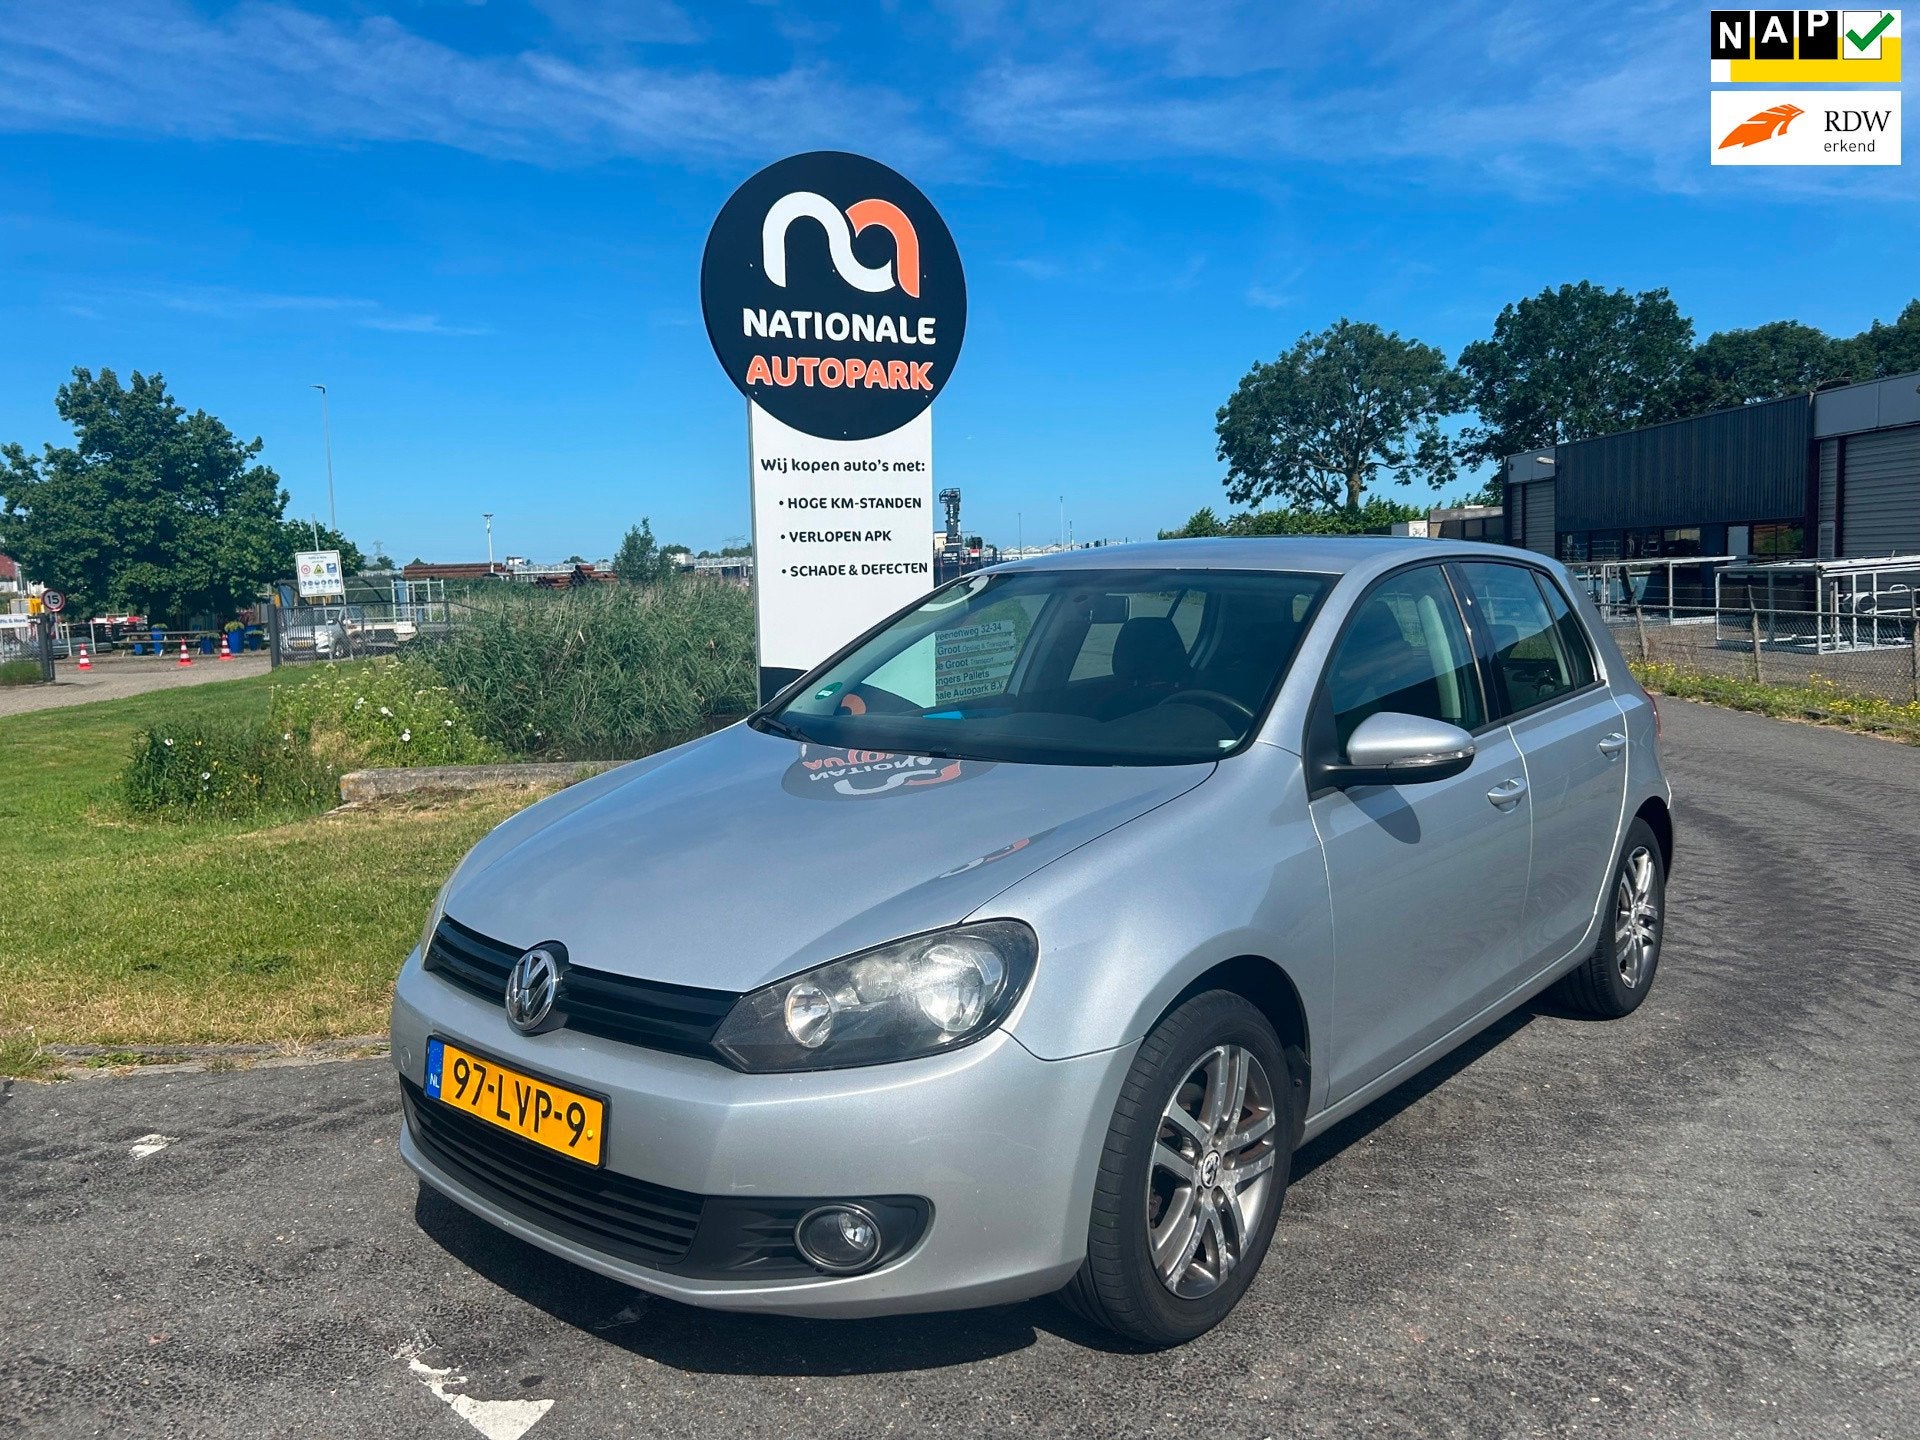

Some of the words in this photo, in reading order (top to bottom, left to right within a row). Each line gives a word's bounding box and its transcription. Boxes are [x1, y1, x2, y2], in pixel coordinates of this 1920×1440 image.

[742, 308, 937, 345] NATIONALE
[746, 355, 934, 390] AUTOPARK
[761, 458, 788, 473] Wij
[792, 458, 839, 473] kopen
[893, 460, 925, 472] met:
[788, 498, 827, 509] HOGE
[831, 498, 922, 509] KM-STANDEN
[789, 531, 861, 543] VERLOPEN
[865, 530, 892, 542] APK
[791, 564, 846, 576] SCHADE
[849, 565, 858, 575] &
[862, 563, 928, 575] DEFECTEN
[47, 595, 60, 605] 15
[981, 623, 1002, 633] 32-34
[937, 645, 961, 656] Groot
[945, 658, 968, 669] Groot
[963, 670, 990, 681] Pallets
[953, 684, 989, 698] Autopark
[429, 1073, 440, 1089] NL
[453, 1057, 586, 1148] 97-LVP-9
